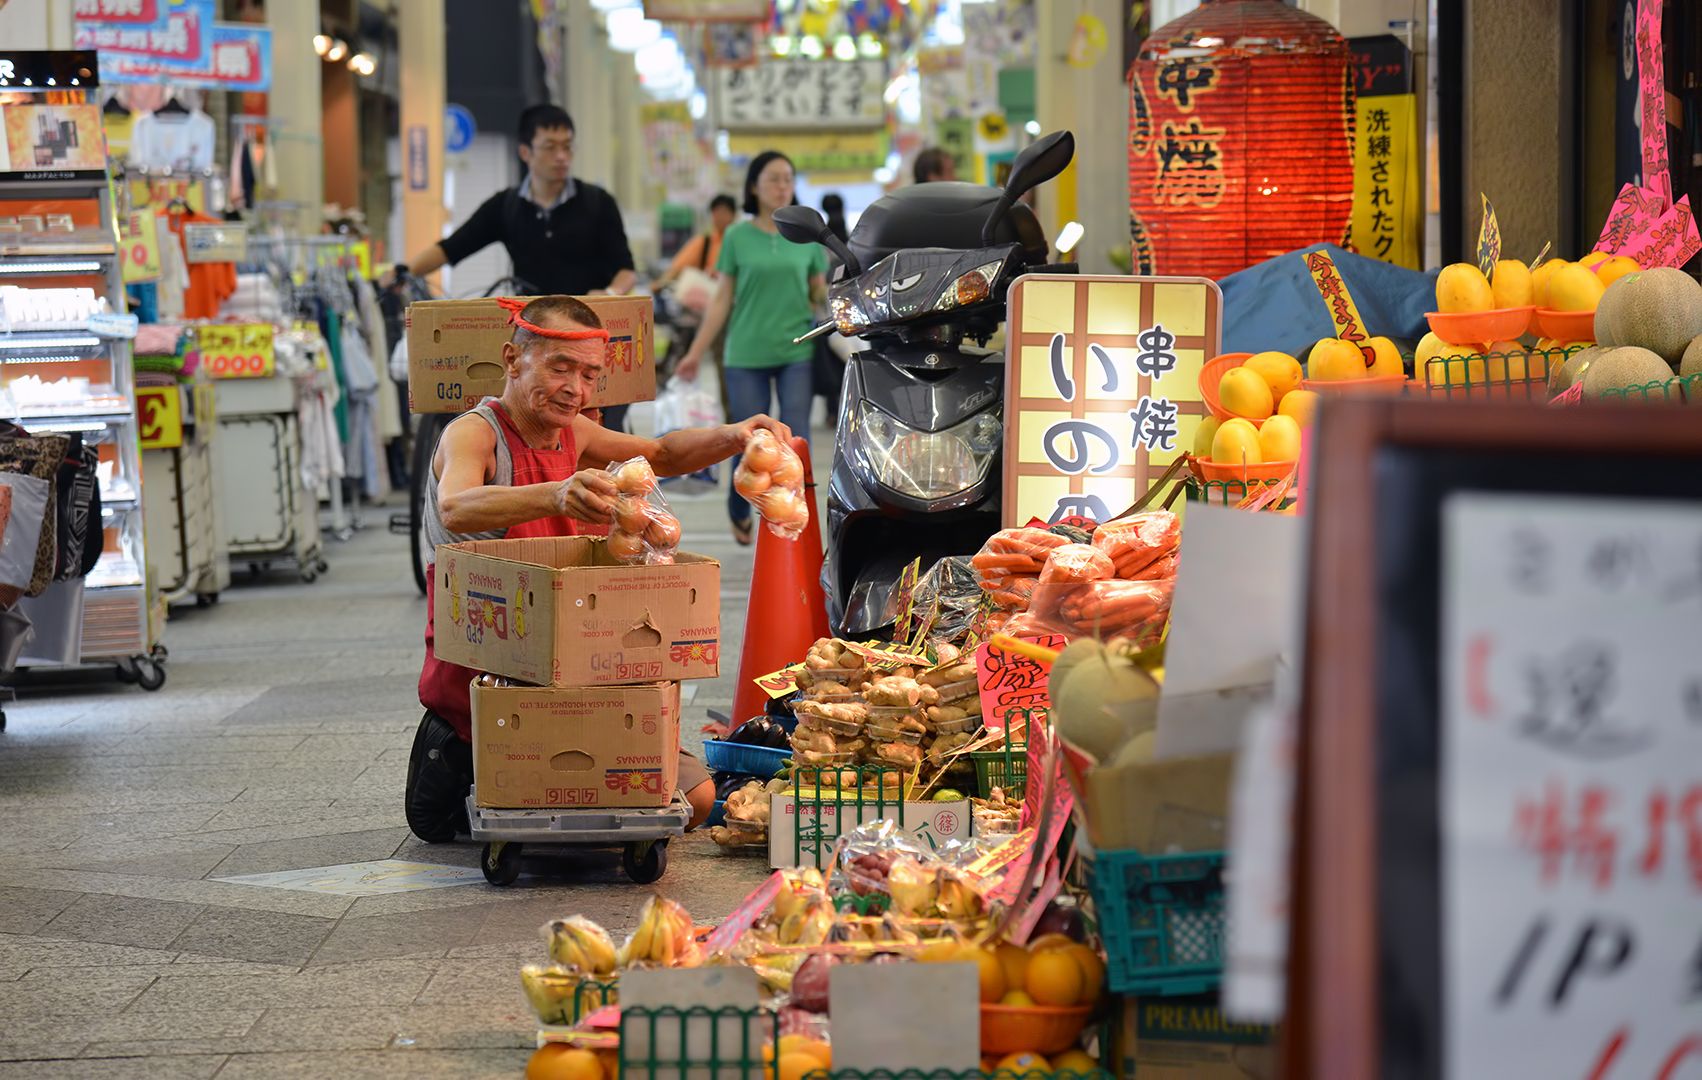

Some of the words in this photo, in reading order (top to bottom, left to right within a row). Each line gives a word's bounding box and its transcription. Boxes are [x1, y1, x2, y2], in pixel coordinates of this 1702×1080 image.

[1366, 108, 1395, 265] 洗練されたク
[437, 382, 462, 400] CPD
[1131, 325, 1177, 450] 串焼
[468, 571, 503, 591] BANANAS
[680, 626, 718, 638] BANANAS
[616, 755, 662, 764] BANANAS
